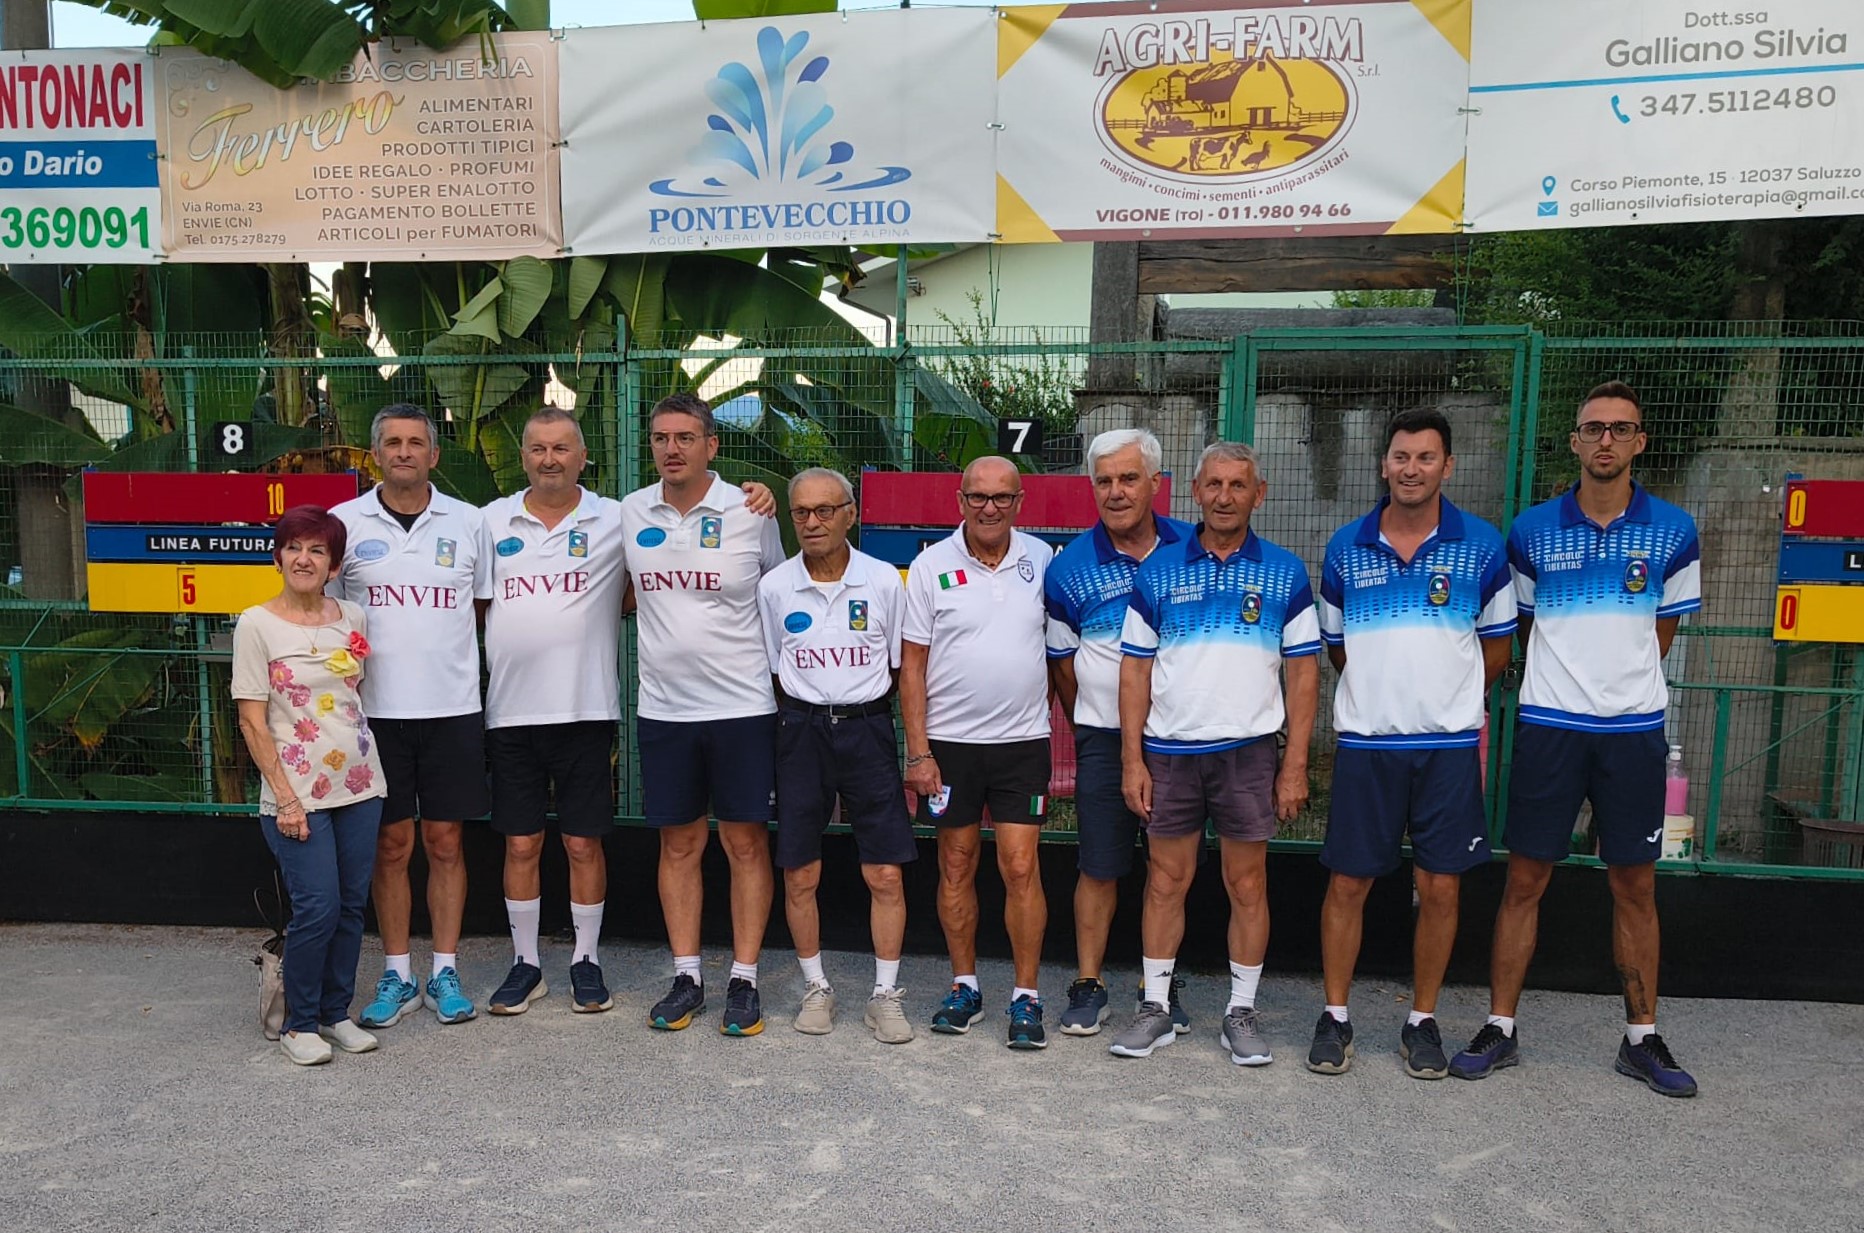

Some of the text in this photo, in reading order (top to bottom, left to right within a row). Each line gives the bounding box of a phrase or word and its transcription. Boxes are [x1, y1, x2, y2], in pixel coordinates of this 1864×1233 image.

[1684, 11, 1769, 29] Dott.ssa
[1093, 15, 1364, 77] AGRI-FARM
[1605, 27, 1848, 68] Galliano Silvia
[300, 57, 534, 86] BACCHERIA
[419, 97, 533, 113] ALIMENTARI
[1640, 85, 1837, 118] 347.5112480
[417, 118, 534, 135] CARTOLERIA
[180, 90, 405, 191] Ferrero
[381, 139, 534, 157] PRODOTTI TIPICI
[24, 150, 103, 176] Dario
[313, 160, 534, 180] IDEE REGALO PROFUMI
[1099, 148, 1350, 202] mangimi concimi sementi antiparassitari
[1570, 166, 1862, 193] Corso Piemonte, 15 12037 Saluzzo
[295, 181, 535, 201] LOTTO SUPER ENALOTTO
[182, 202, 201, 213] Via
[248, 201, 263, 213] 23
[322, 202, 536, 221] PAGAMENTO BOLLETTE
[648, 199, 911, 233] PONTEVECCHIO
[1096, 208, 1171, 223] VIGONE
[1175, 209, 1204, 223] (TO)
[1218, 205, 1295, 221] 011.980
[1299, 205, 1323, 219] 94
[1328, 203, 1352, 218] 66
[0, 206, 150, 250] 369091
[183, 215, 253, 229] ENVIE (CN)
[317, 223, 537, 243] ARTICOLI per FUMATORI
[649, 235, 695, 246] ACQUE
[766, 231, 779, 242] DI
[784, 229, 857, 241] SORGENTE
[862, 227, 911, 239] ALPINA
[221, 423, 245, 455] 8
[1007, 421, 1033, 454] 7
[266, 482, 285, 516] 10
[1789, 489, 1807, 527] 0
[150, 537, 275, 552] LINEA FUTURA
[1544, 551, 1581, 563] CIRCOLO
[1544, 560, 1582, 572] LIBERTAS
[181, 574, 196, 606] 5
[504, 571, 589, 601] ENVIE
[639, 570, 722, 593] ENVIE
[1354, 576, 1387, 589] LIBERTAS
[367, 584, 458, 610] ENVIE
[1100, 586, 1133, 602] LIBERTAS
[1171, 593, 1203, 605] LIBERTAS
[1780, 594, 1797, 630] 0
[795, 645, 871, 669] ENVIE
